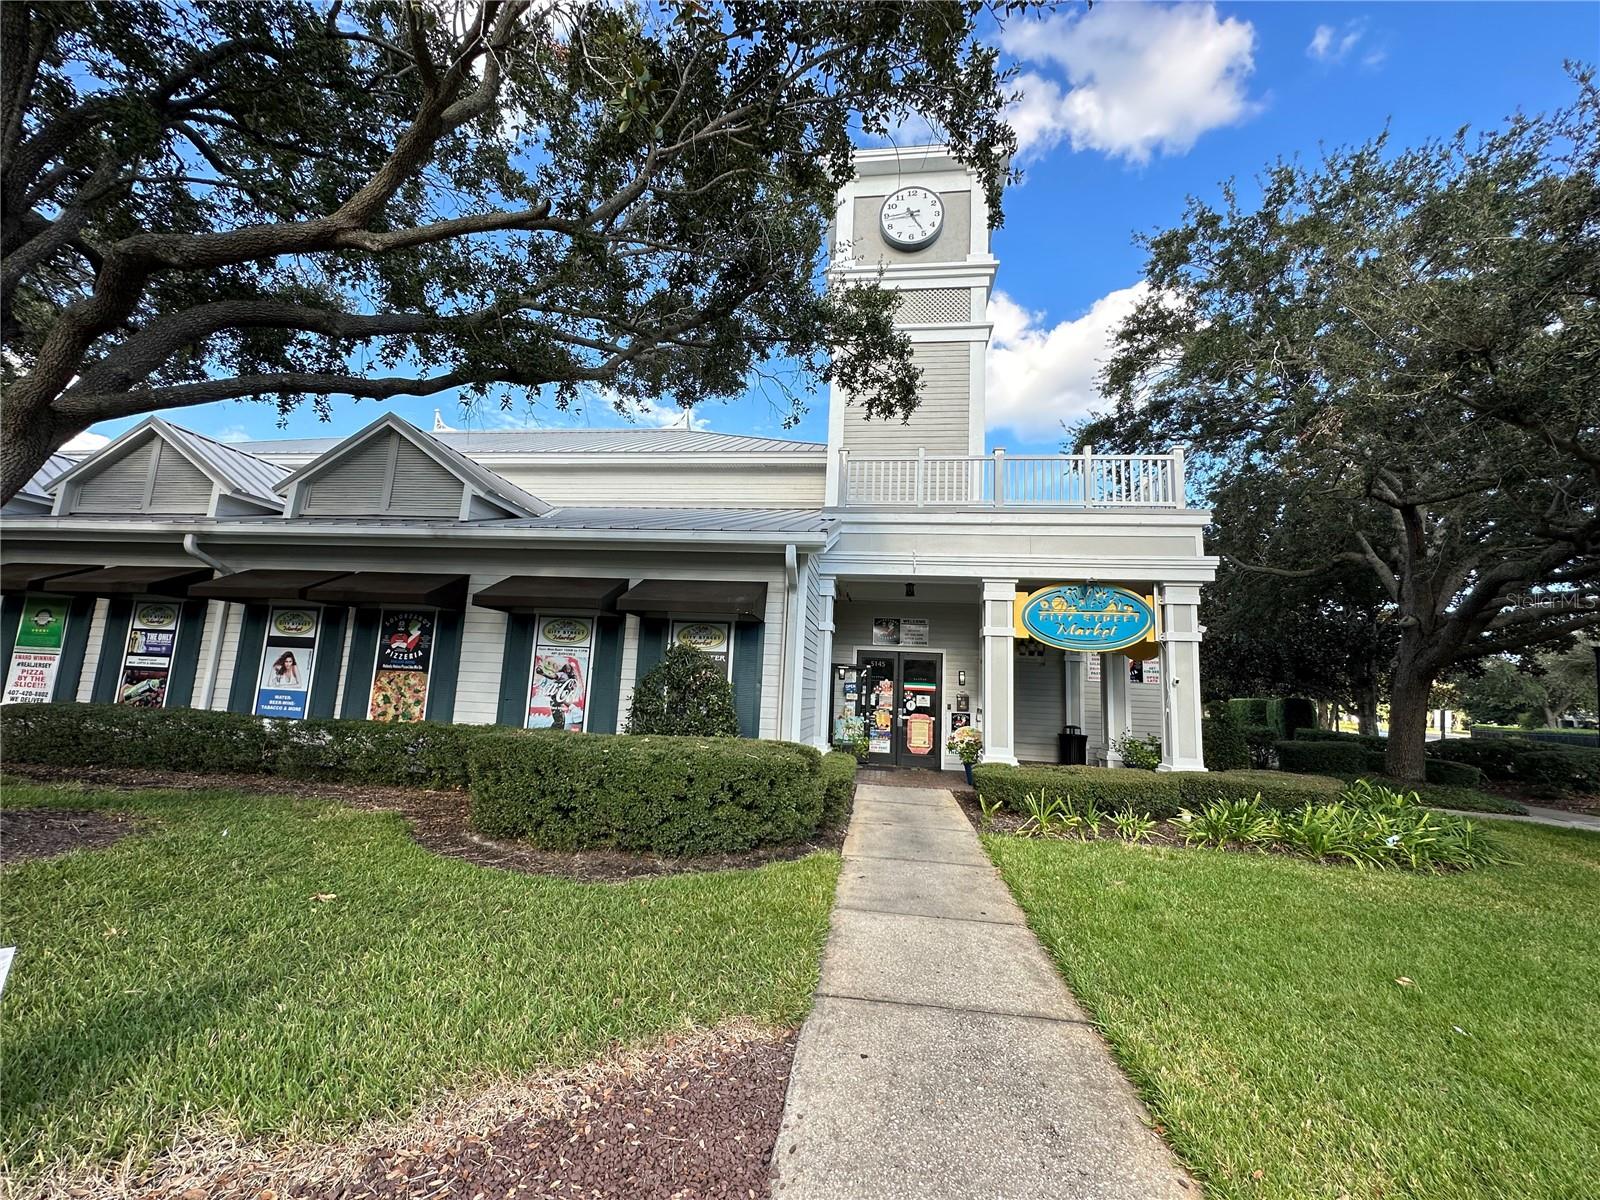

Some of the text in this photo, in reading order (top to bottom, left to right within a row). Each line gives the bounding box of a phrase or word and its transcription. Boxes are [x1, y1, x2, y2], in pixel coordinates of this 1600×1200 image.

[1083, 612, 1140, 623] STREET
[1055, 620, 1118, 638] Market
[147, 632, 173, 641] THE ONLY
[385, 649, 424, 660] PIZZERIA
